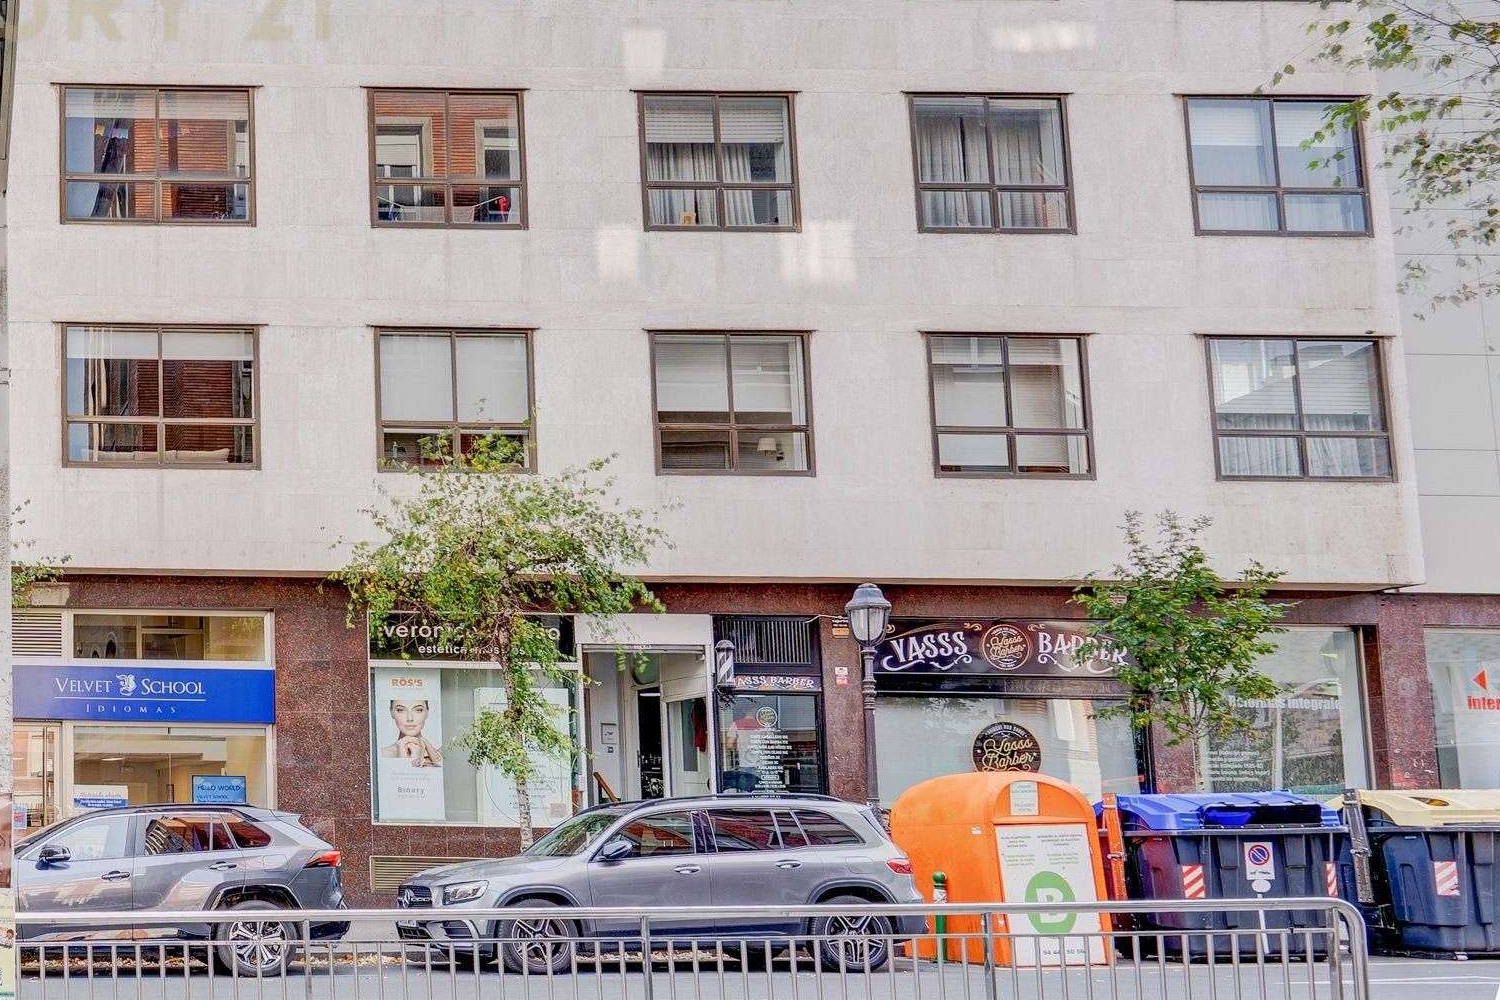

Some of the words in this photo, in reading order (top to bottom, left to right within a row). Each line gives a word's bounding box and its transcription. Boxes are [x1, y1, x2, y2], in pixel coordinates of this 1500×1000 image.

[889, 630, 969, 663] YASSS
[737, 675, 767, 686] ASSS
[770, 675, 815, 688] BARBER
[397, 786, 425, 795] Binary
